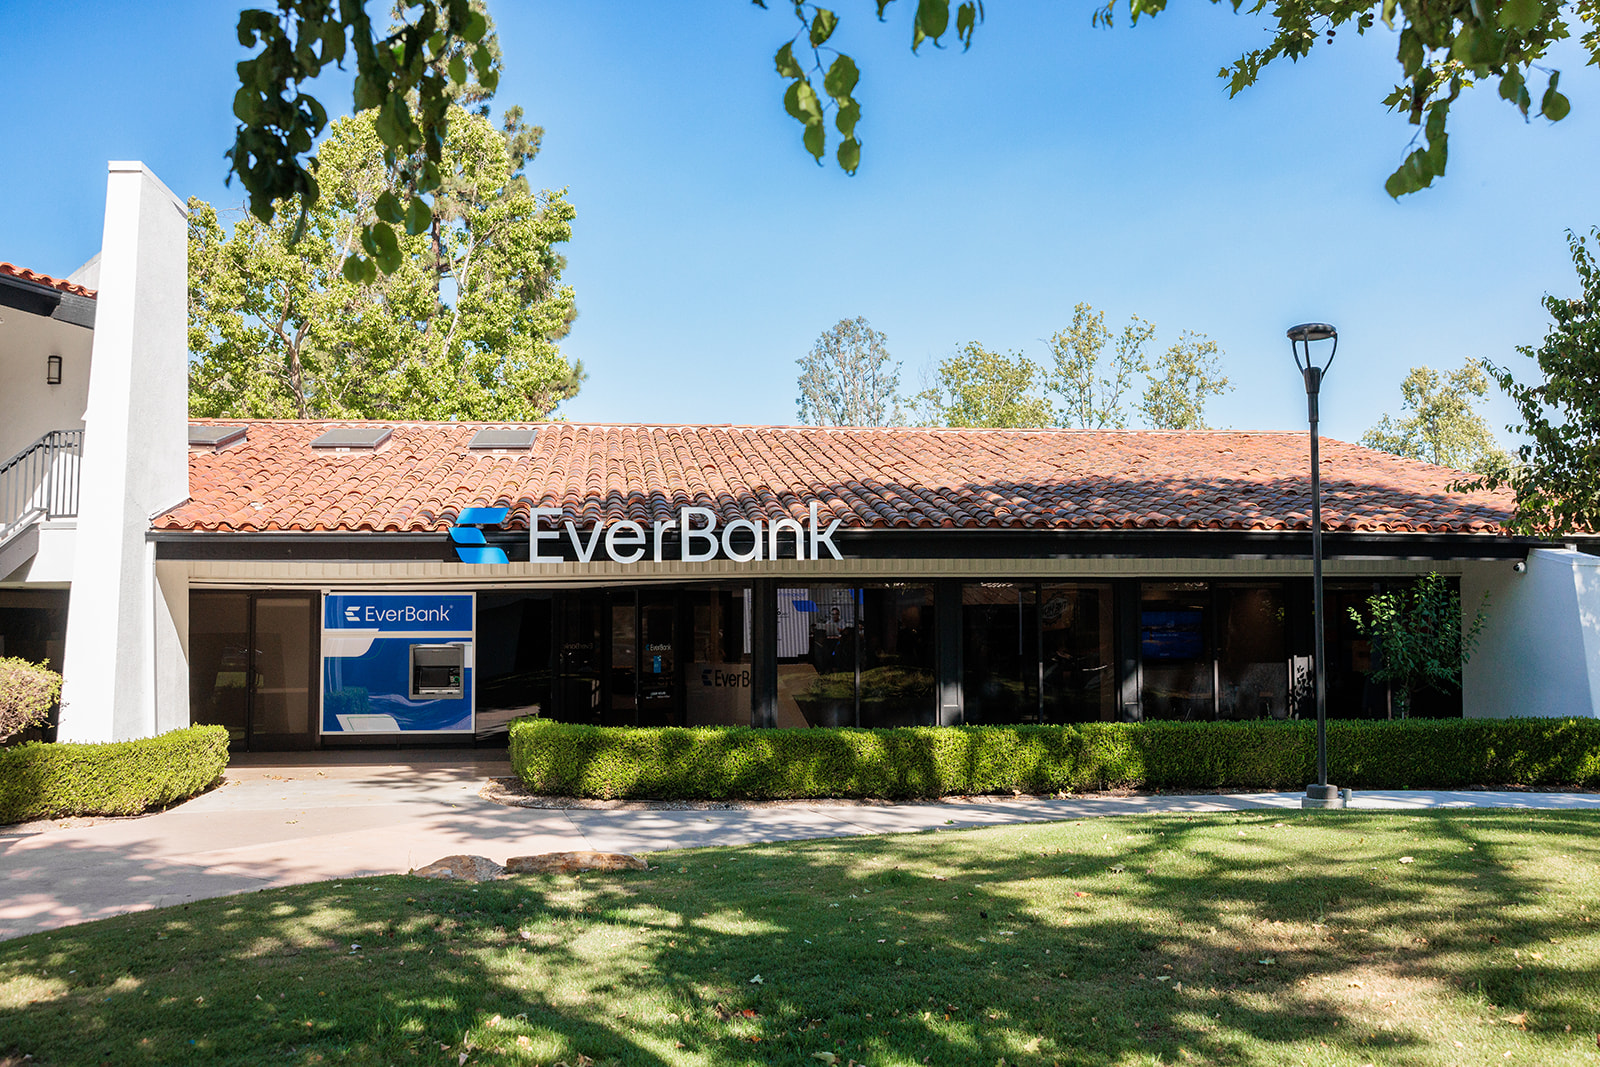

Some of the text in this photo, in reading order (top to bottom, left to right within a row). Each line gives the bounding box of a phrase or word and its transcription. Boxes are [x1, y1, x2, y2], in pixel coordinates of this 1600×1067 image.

[529, 502, 844, 564] EverBank
[365, 605, 450, 622] EverBank
[650, 643, 672, 652] EverBank
[715, 670, 751, 688] EverB
